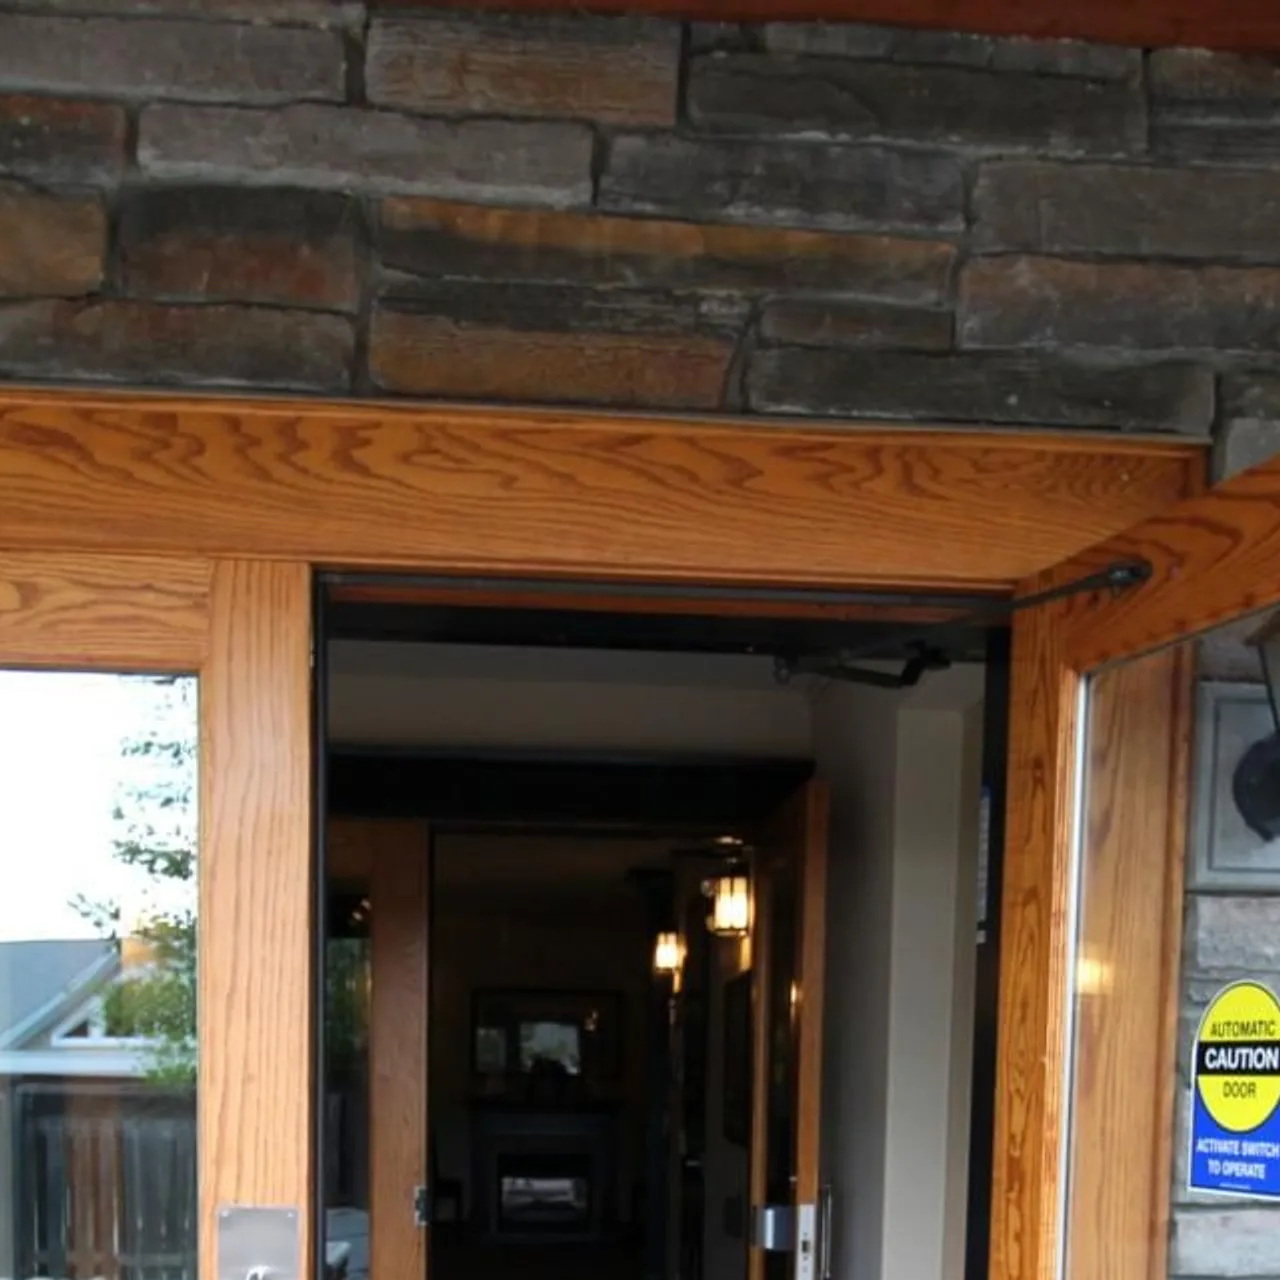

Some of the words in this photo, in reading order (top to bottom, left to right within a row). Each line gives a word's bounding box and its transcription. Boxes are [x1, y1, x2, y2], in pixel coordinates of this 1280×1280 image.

[1210, 1020, 1276, 1037] AUTOMATIC
[1204, 1046, 1279, 1069] CAUTION
[1223, 1081, 1257, 1098] DOOR
[1208, 1159, 1221, 1175] TO
[1223, 1161, 1266, 1179] OPERATE
